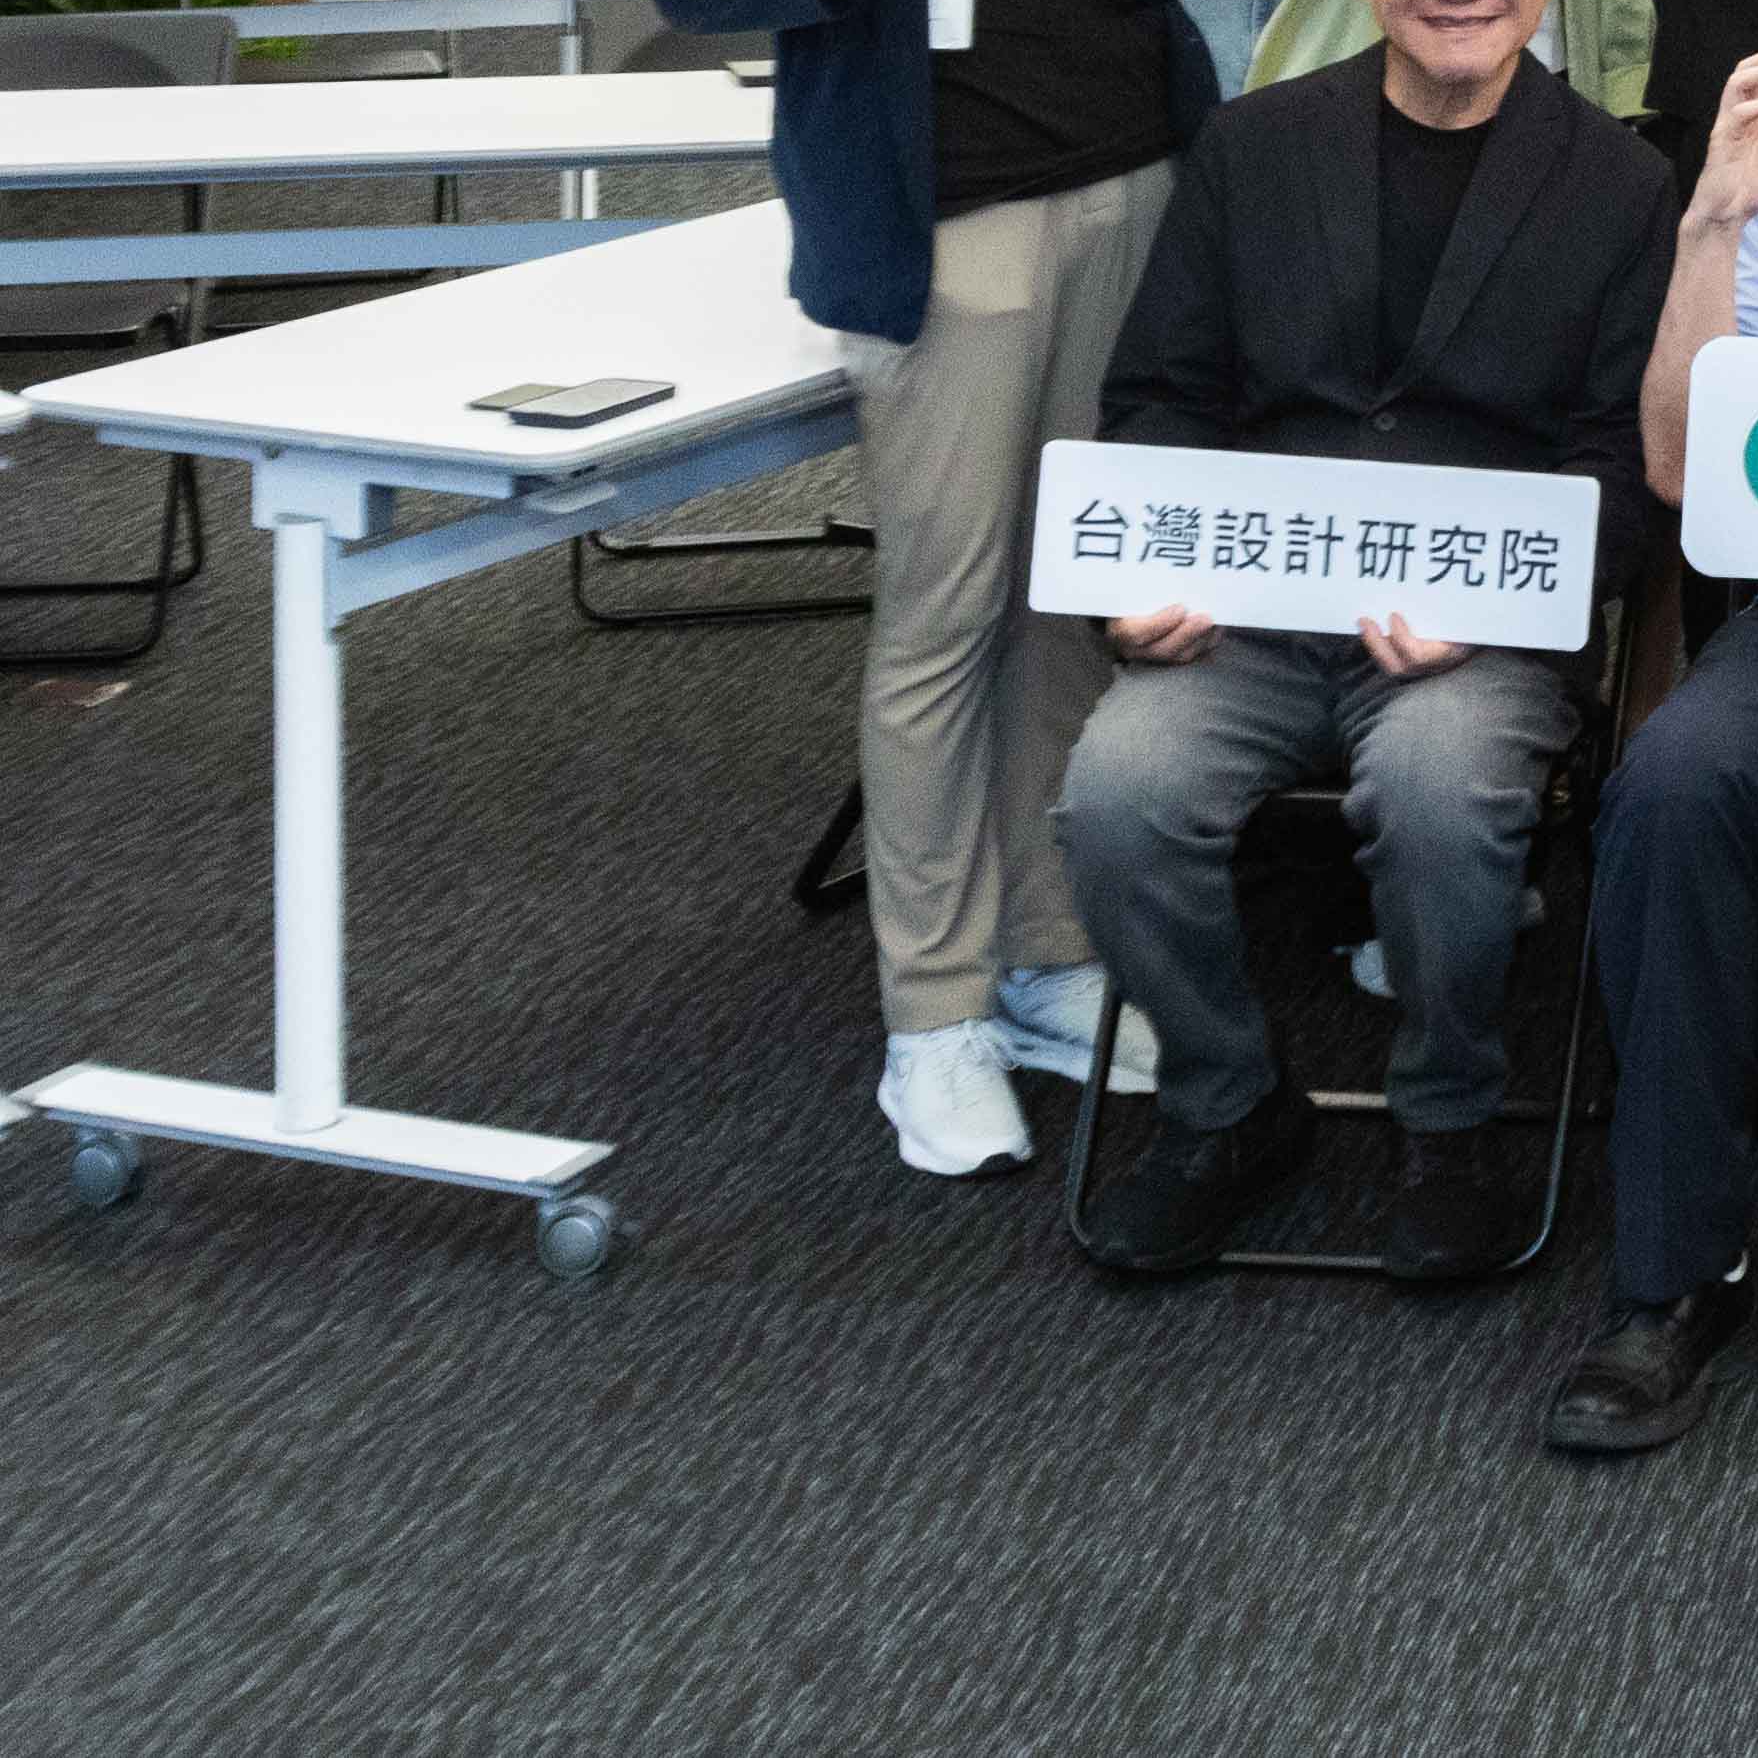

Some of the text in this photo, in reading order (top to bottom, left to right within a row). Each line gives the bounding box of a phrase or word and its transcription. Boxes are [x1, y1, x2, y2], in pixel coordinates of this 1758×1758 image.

[1072, 498, 1560, 594] 台灣設計研究院
